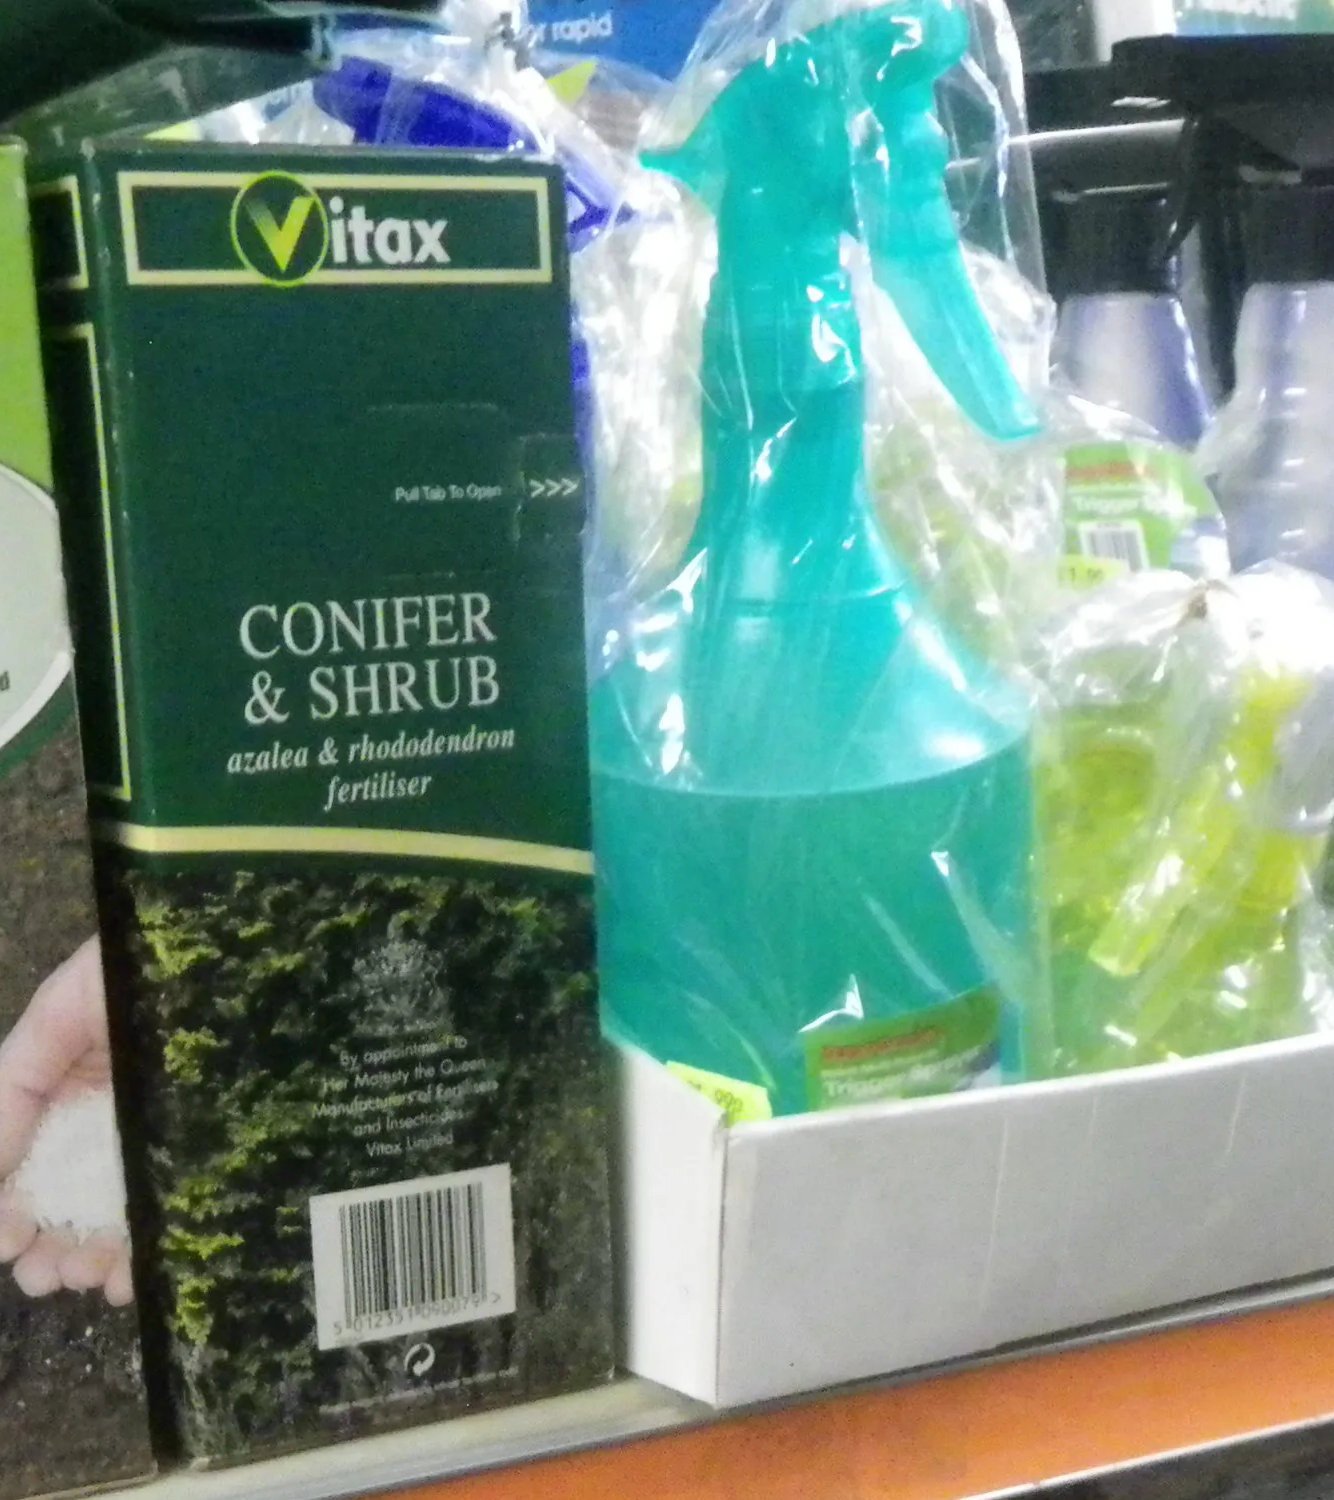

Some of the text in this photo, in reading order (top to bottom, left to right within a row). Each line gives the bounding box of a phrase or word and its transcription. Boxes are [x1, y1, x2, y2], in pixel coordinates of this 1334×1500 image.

[553, 12, 614, 43] rapid
[243, 194, 452, 274] Vitax
[239, 591, 498, 661] CONIFER
[243, 655, 500, 726] & SHRUB
[226, 725, 516, 775] azalea & rhododendron
[323, 776, 433, 813] fertiliser
